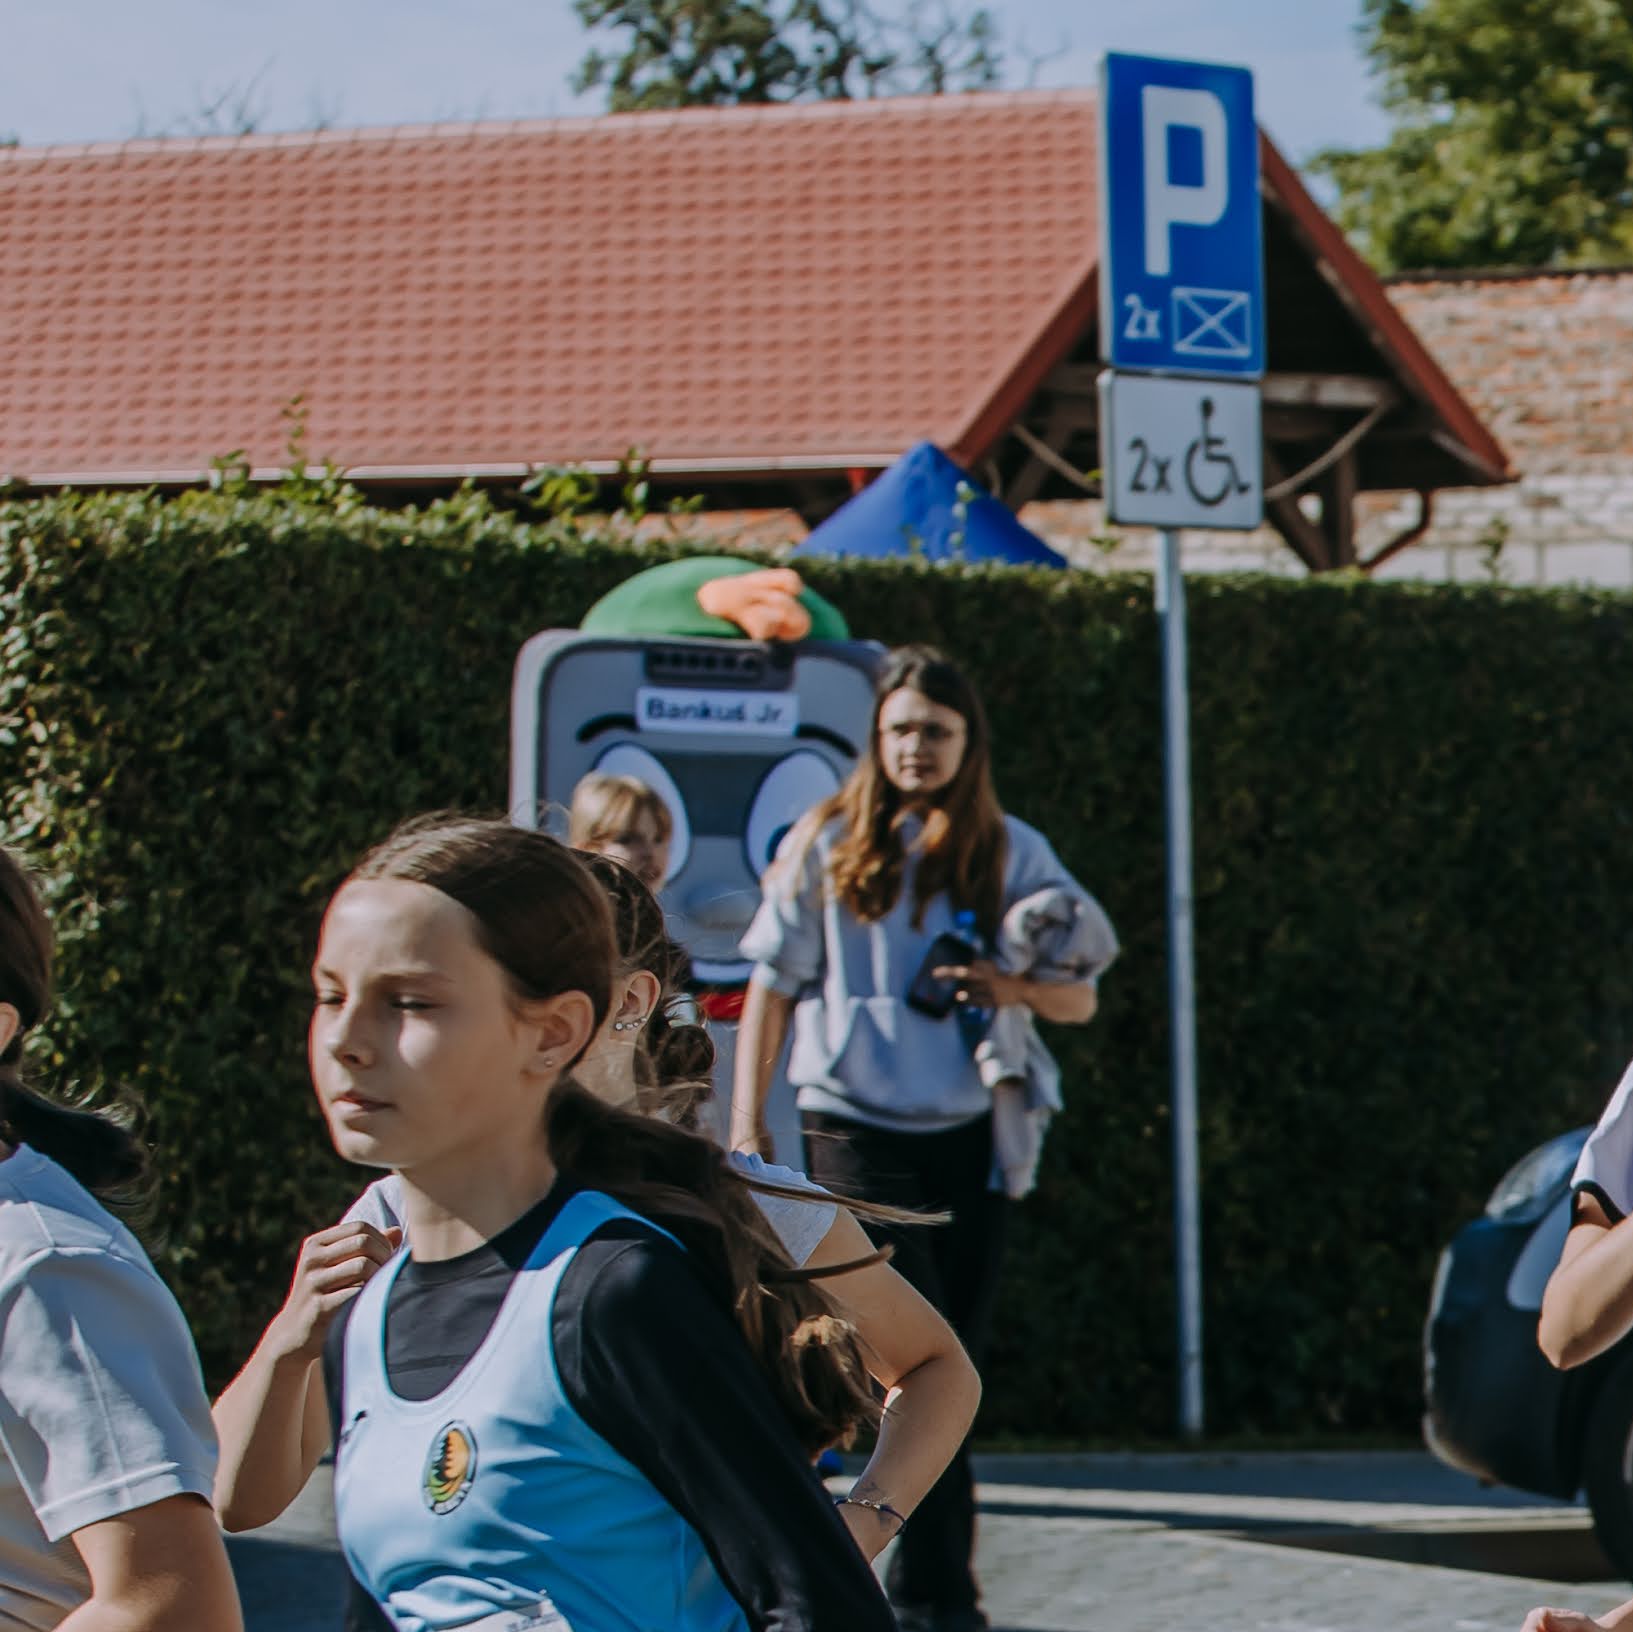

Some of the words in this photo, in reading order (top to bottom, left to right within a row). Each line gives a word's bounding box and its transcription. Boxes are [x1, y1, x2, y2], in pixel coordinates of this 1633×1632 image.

[1142, 84, 1228, 277] P
[1124, 294, 1161, 340] 2x
[1127, 438, 1172, 494] 2x
